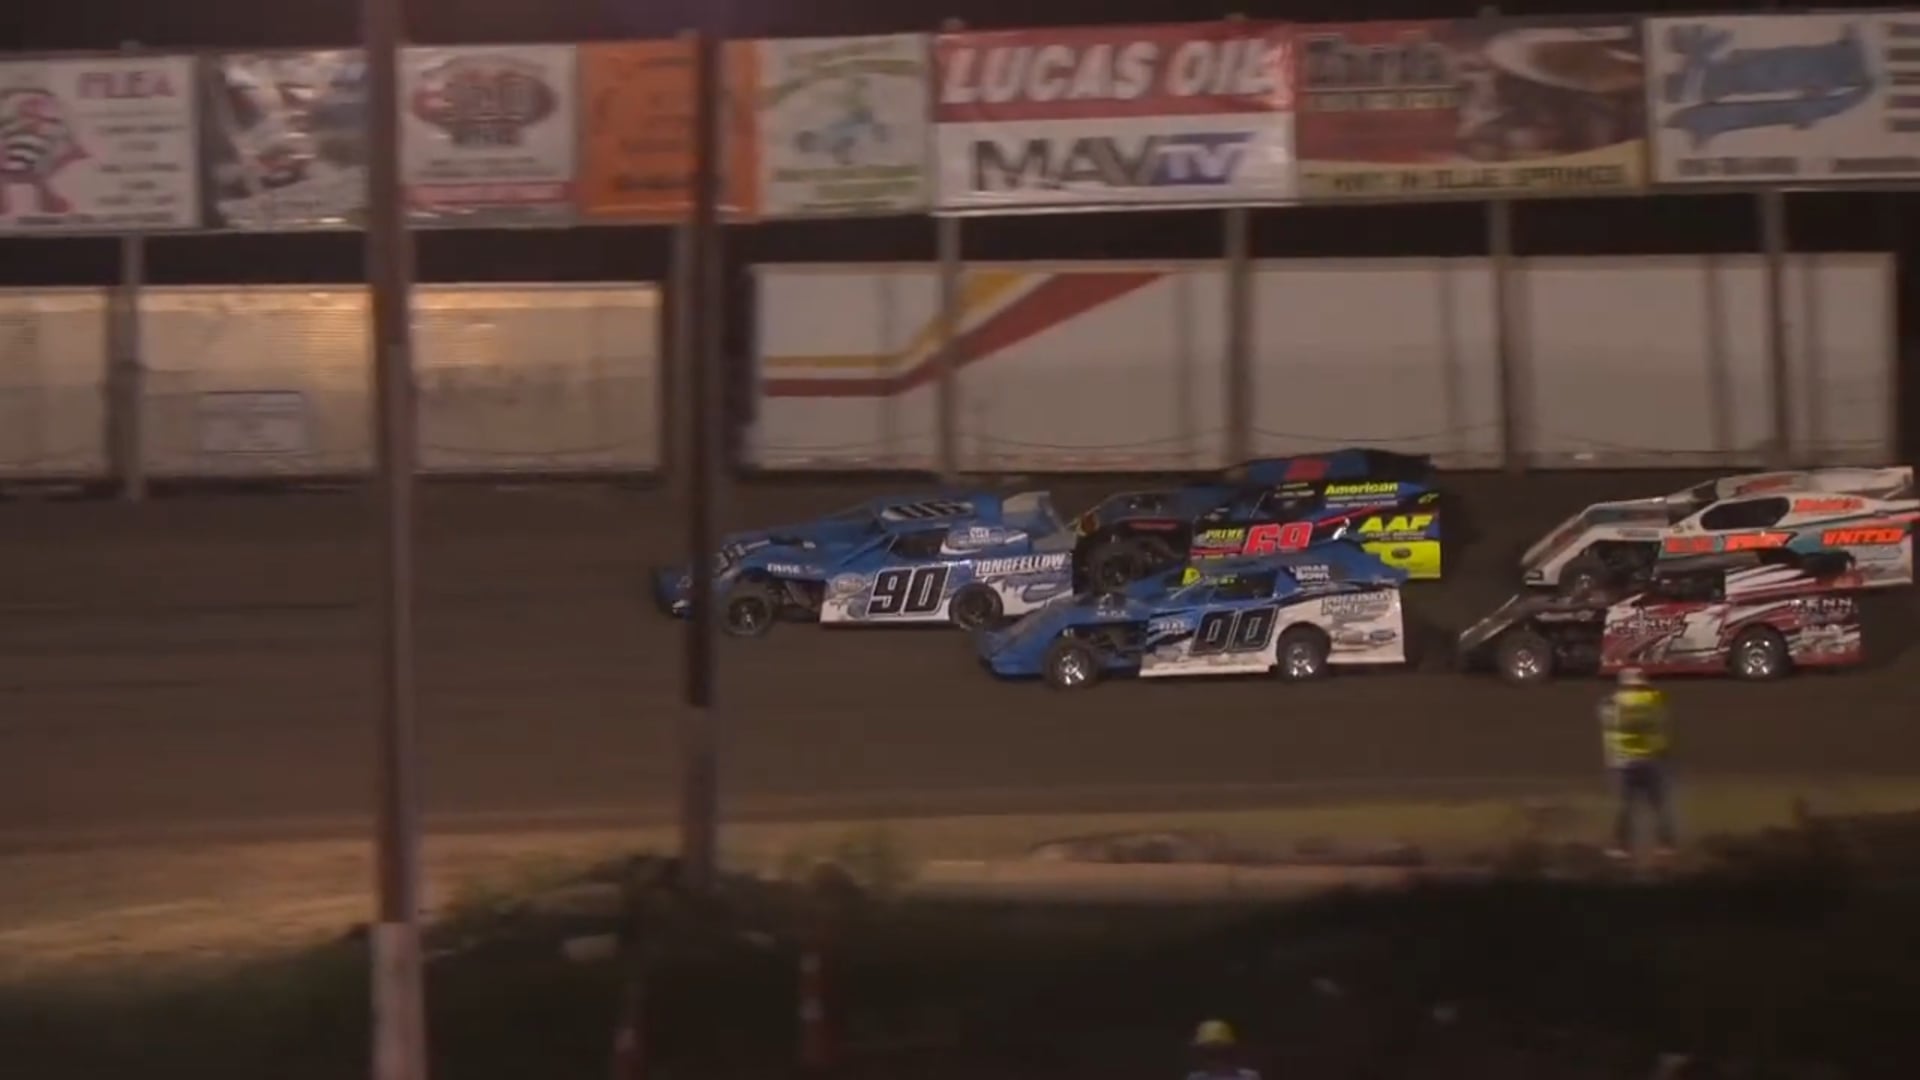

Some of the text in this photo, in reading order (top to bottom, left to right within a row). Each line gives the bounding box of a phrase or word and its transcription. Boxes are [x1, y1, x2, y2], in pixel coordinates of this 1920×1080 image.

[78, 71, 176, 98] FLEA
[938, 43, 1158, 104] LUCAS
[1166, 37, 1276, 96] OIL
[1324, 482, 1398, 496] American
[1242, 521, 1314, 556] 69
[1358, 513, 1434, 534] AAF
[975, 553, 1068, 577] LONGFELLOW
[866, 566, 952, 617] 90
[1190, 596, 1279, 656] 00
